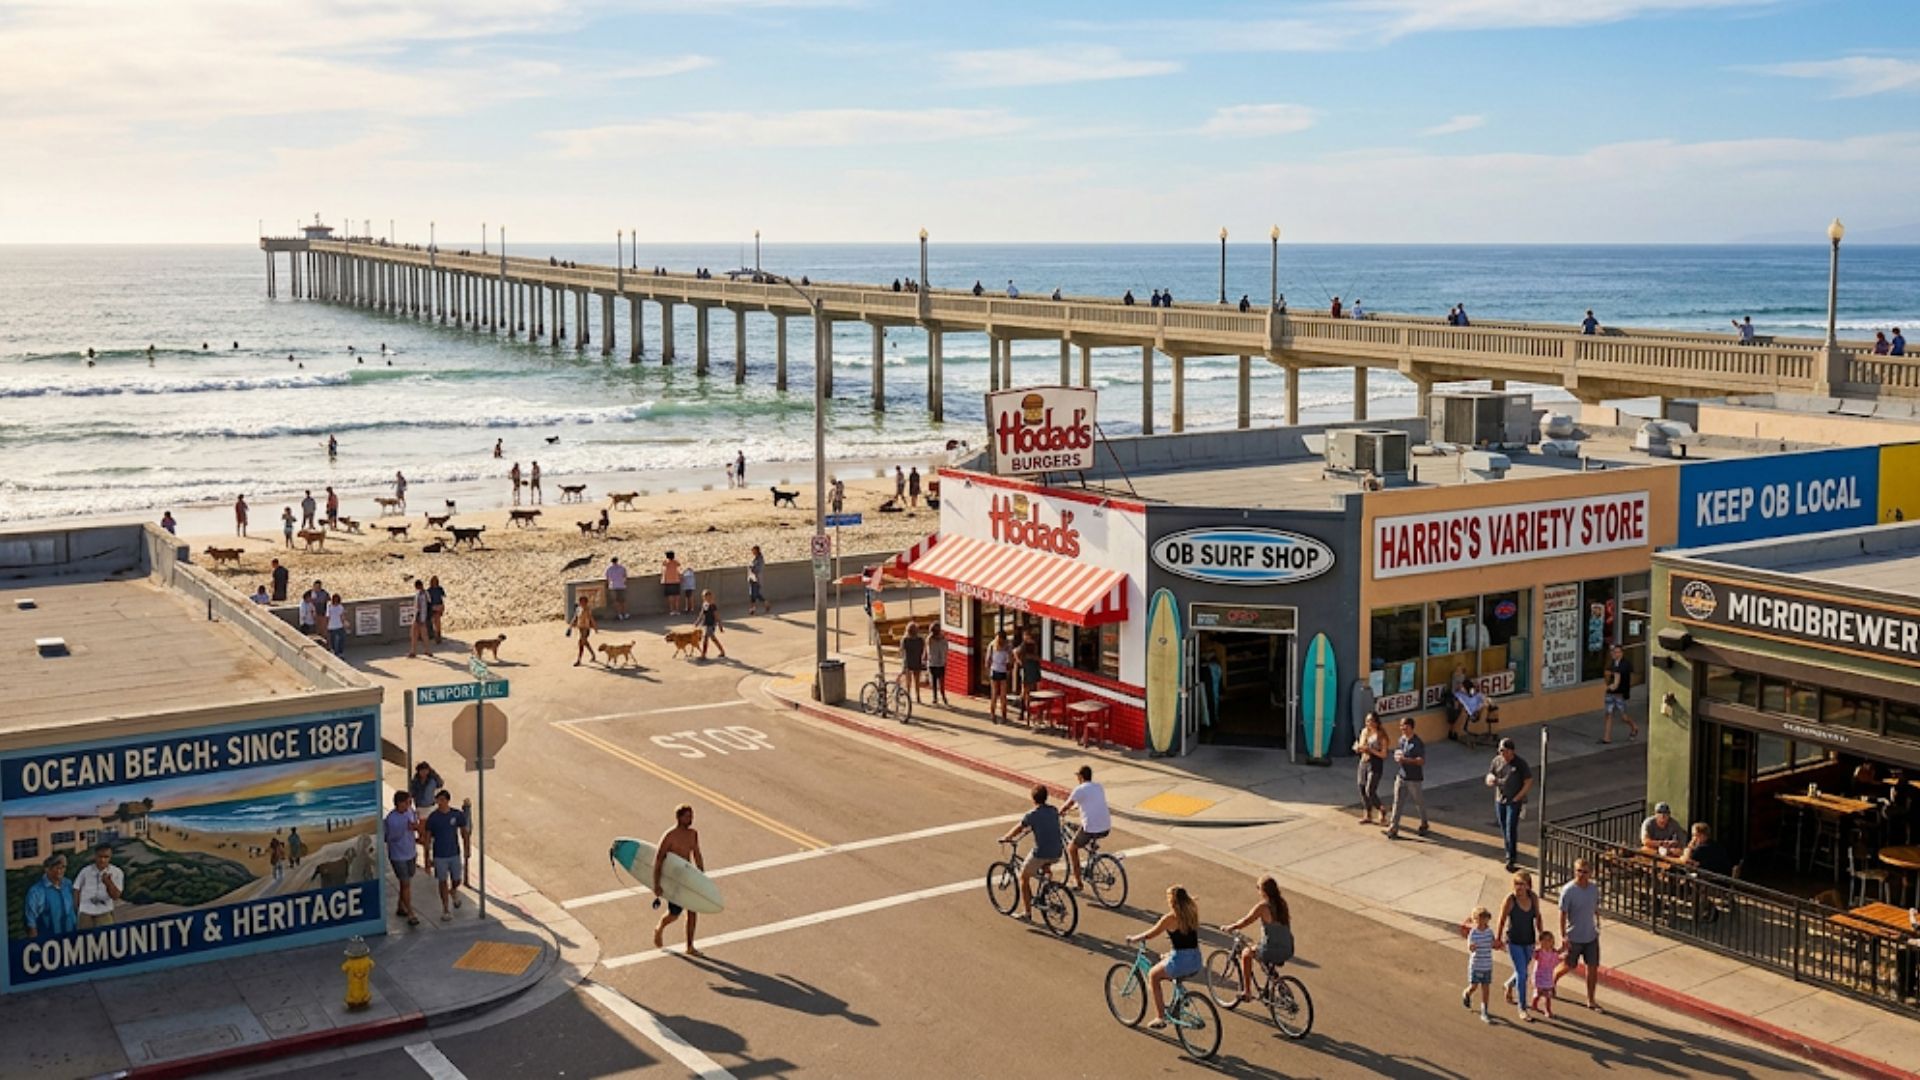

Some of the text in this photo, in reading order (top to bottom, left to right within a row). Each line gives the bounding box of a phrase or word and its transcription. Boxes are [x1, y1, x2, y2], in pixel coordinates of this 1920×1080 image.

[996, 407, 1092, 455] Hodad's
[1011, 453, 1081, 471] BURGERS
[988, 493, 1080, 559] Hodad's
[1696, 475, 1861, 527] KEEP OB LOCAL
[1166, 542, 1319, 569] OB SURF SHOP
[1380, 500, 1644, 570] HARRIS'S VARIETY STORE
[1728, 592, 1920, 654] MICROBREWER
[420, 685, 476, 702] NEWPORT
[22, 721, 363, 793] OCEAN BEACH: SINCE 1887
[650, 725, 775, 759] STOP
[22, 887, 364, 975] COMMUNITY & HERITAGE
